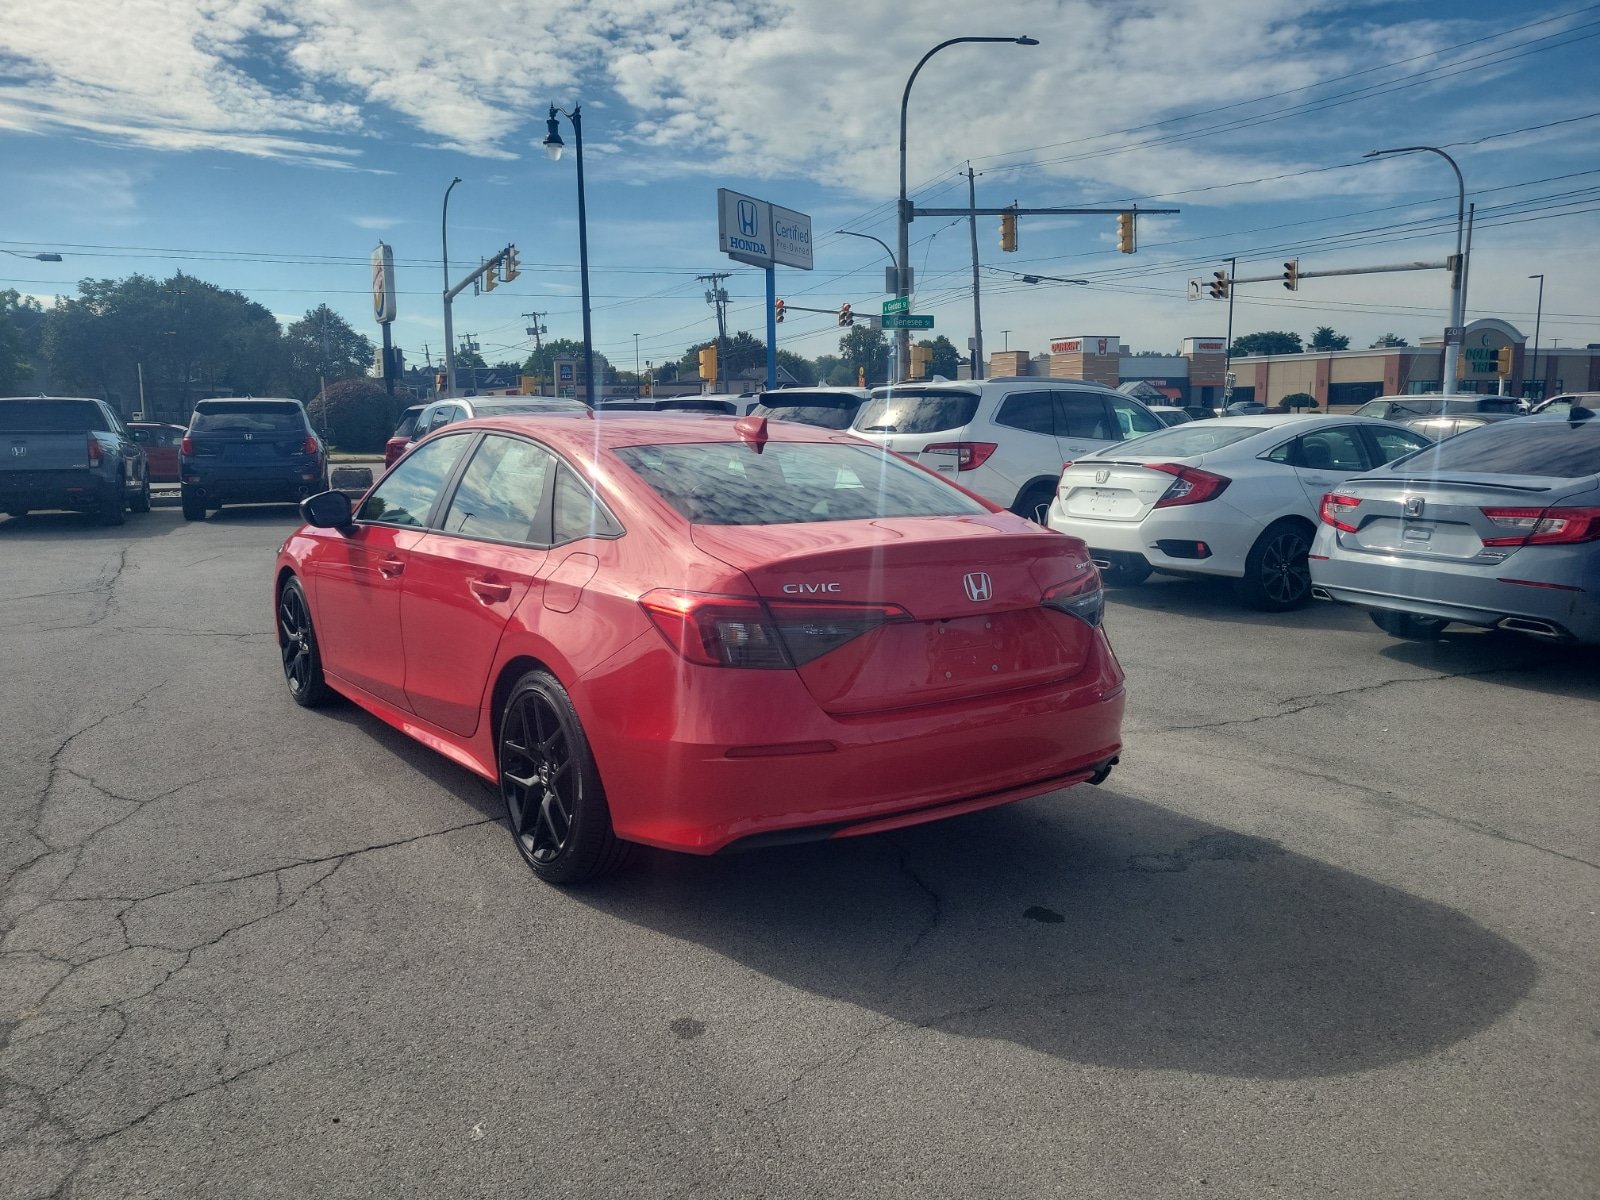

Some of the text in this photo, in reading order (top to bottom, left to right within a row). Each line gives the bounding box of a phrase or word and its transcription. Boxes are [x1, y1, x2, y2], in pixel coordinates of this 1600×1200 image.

[775, 220, 809, 244] Certified
[730, 236, 767, 255] HONDA
[776, 238, 810, 256] Pre-Owned
[893, 317, 923, 327] Genesee
[783, 583, 841, 594] CIVIC
